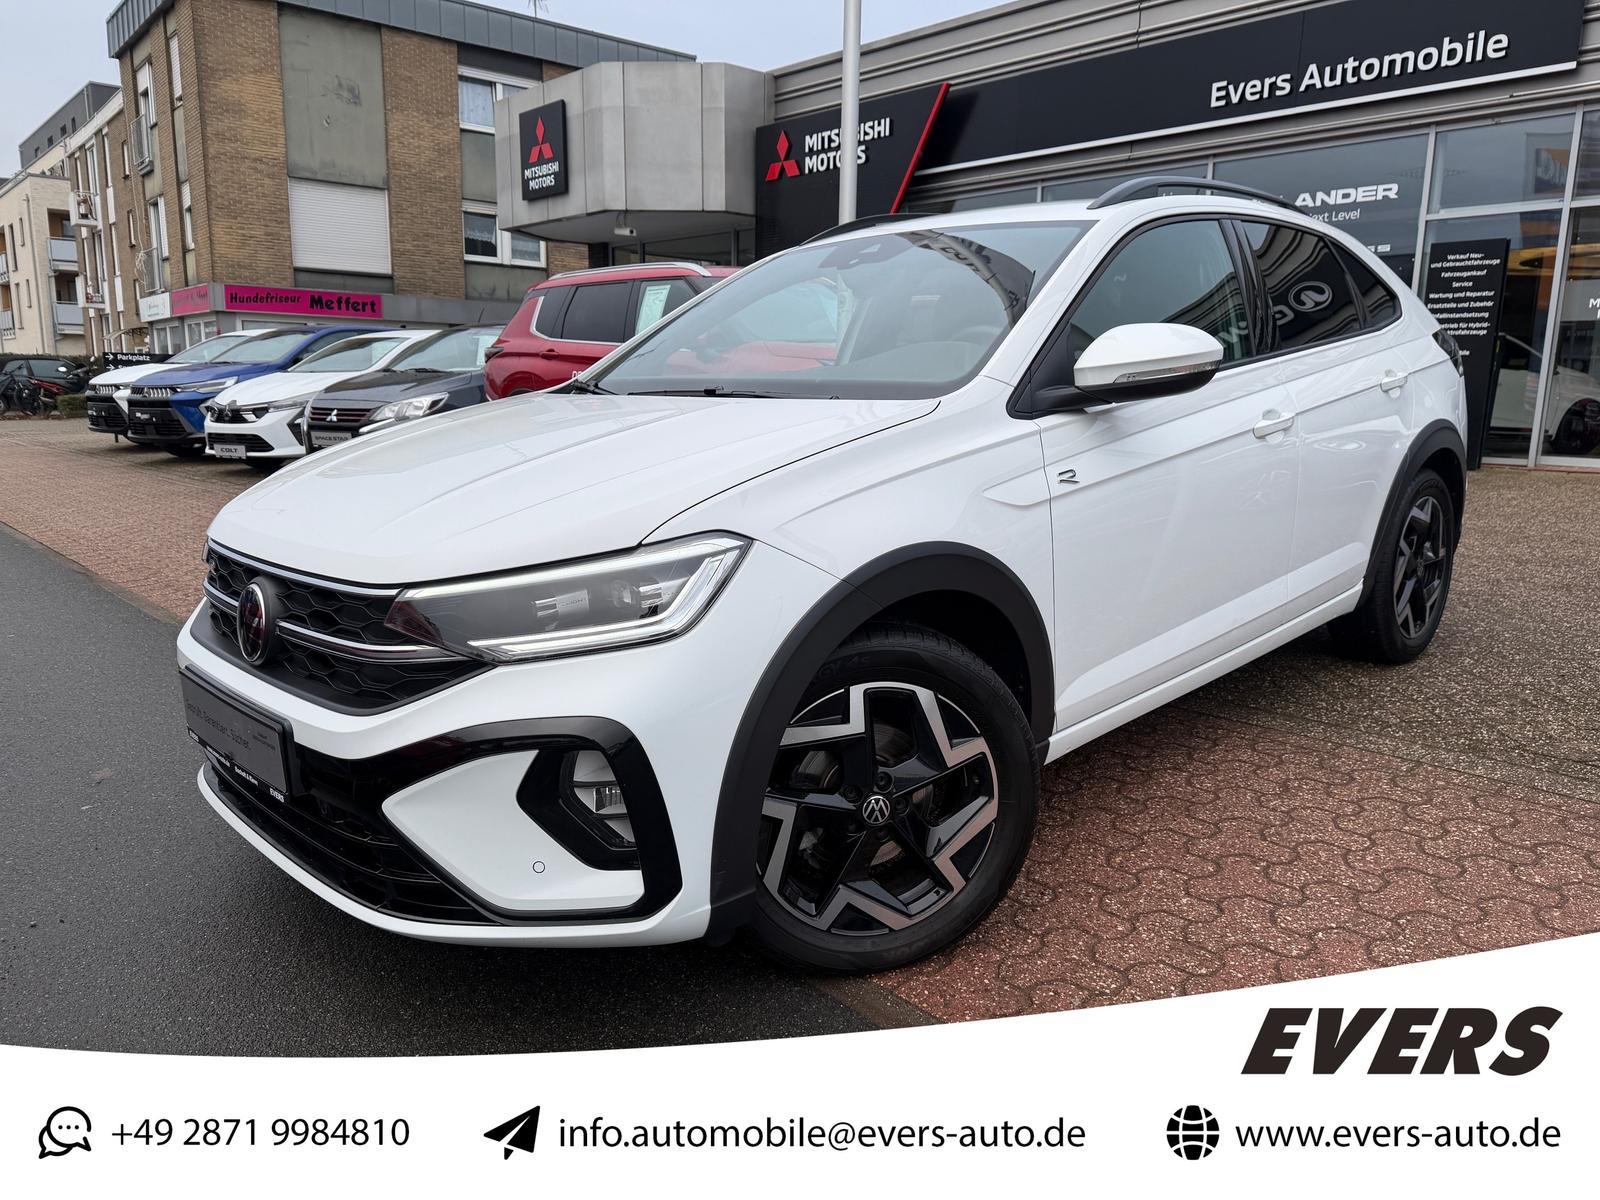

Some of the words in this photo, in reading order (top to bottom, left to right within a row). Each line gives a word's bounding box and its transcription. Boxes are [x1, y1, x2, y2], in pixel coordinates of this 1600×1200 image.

[1210, 72, 1292, 108] Evers
[1299, 29, 1509, 93] Automobile
[804, 117, 891, 153] MITSISHI
[804, 144, 867, 174] MOTOS
[524, 161, 560, 180] MITSUBISHI
[529, 175, 556, 191] MOTORS
[1294, 183, 1399, 207] ANDER
[1310, 213, 1329, 222] ext
[1332, 208, 1360, 222] Level
[1443, 259, 1500, 267] Gebrauchtfahrzeuge
[1441, 269, 1487, 278] Fahrzeugankauf
[229, 292, 301, 305] Hundefriseur
[309, 294, 377, 314] Meffert
[269, 787, 285, 803] EVERS
